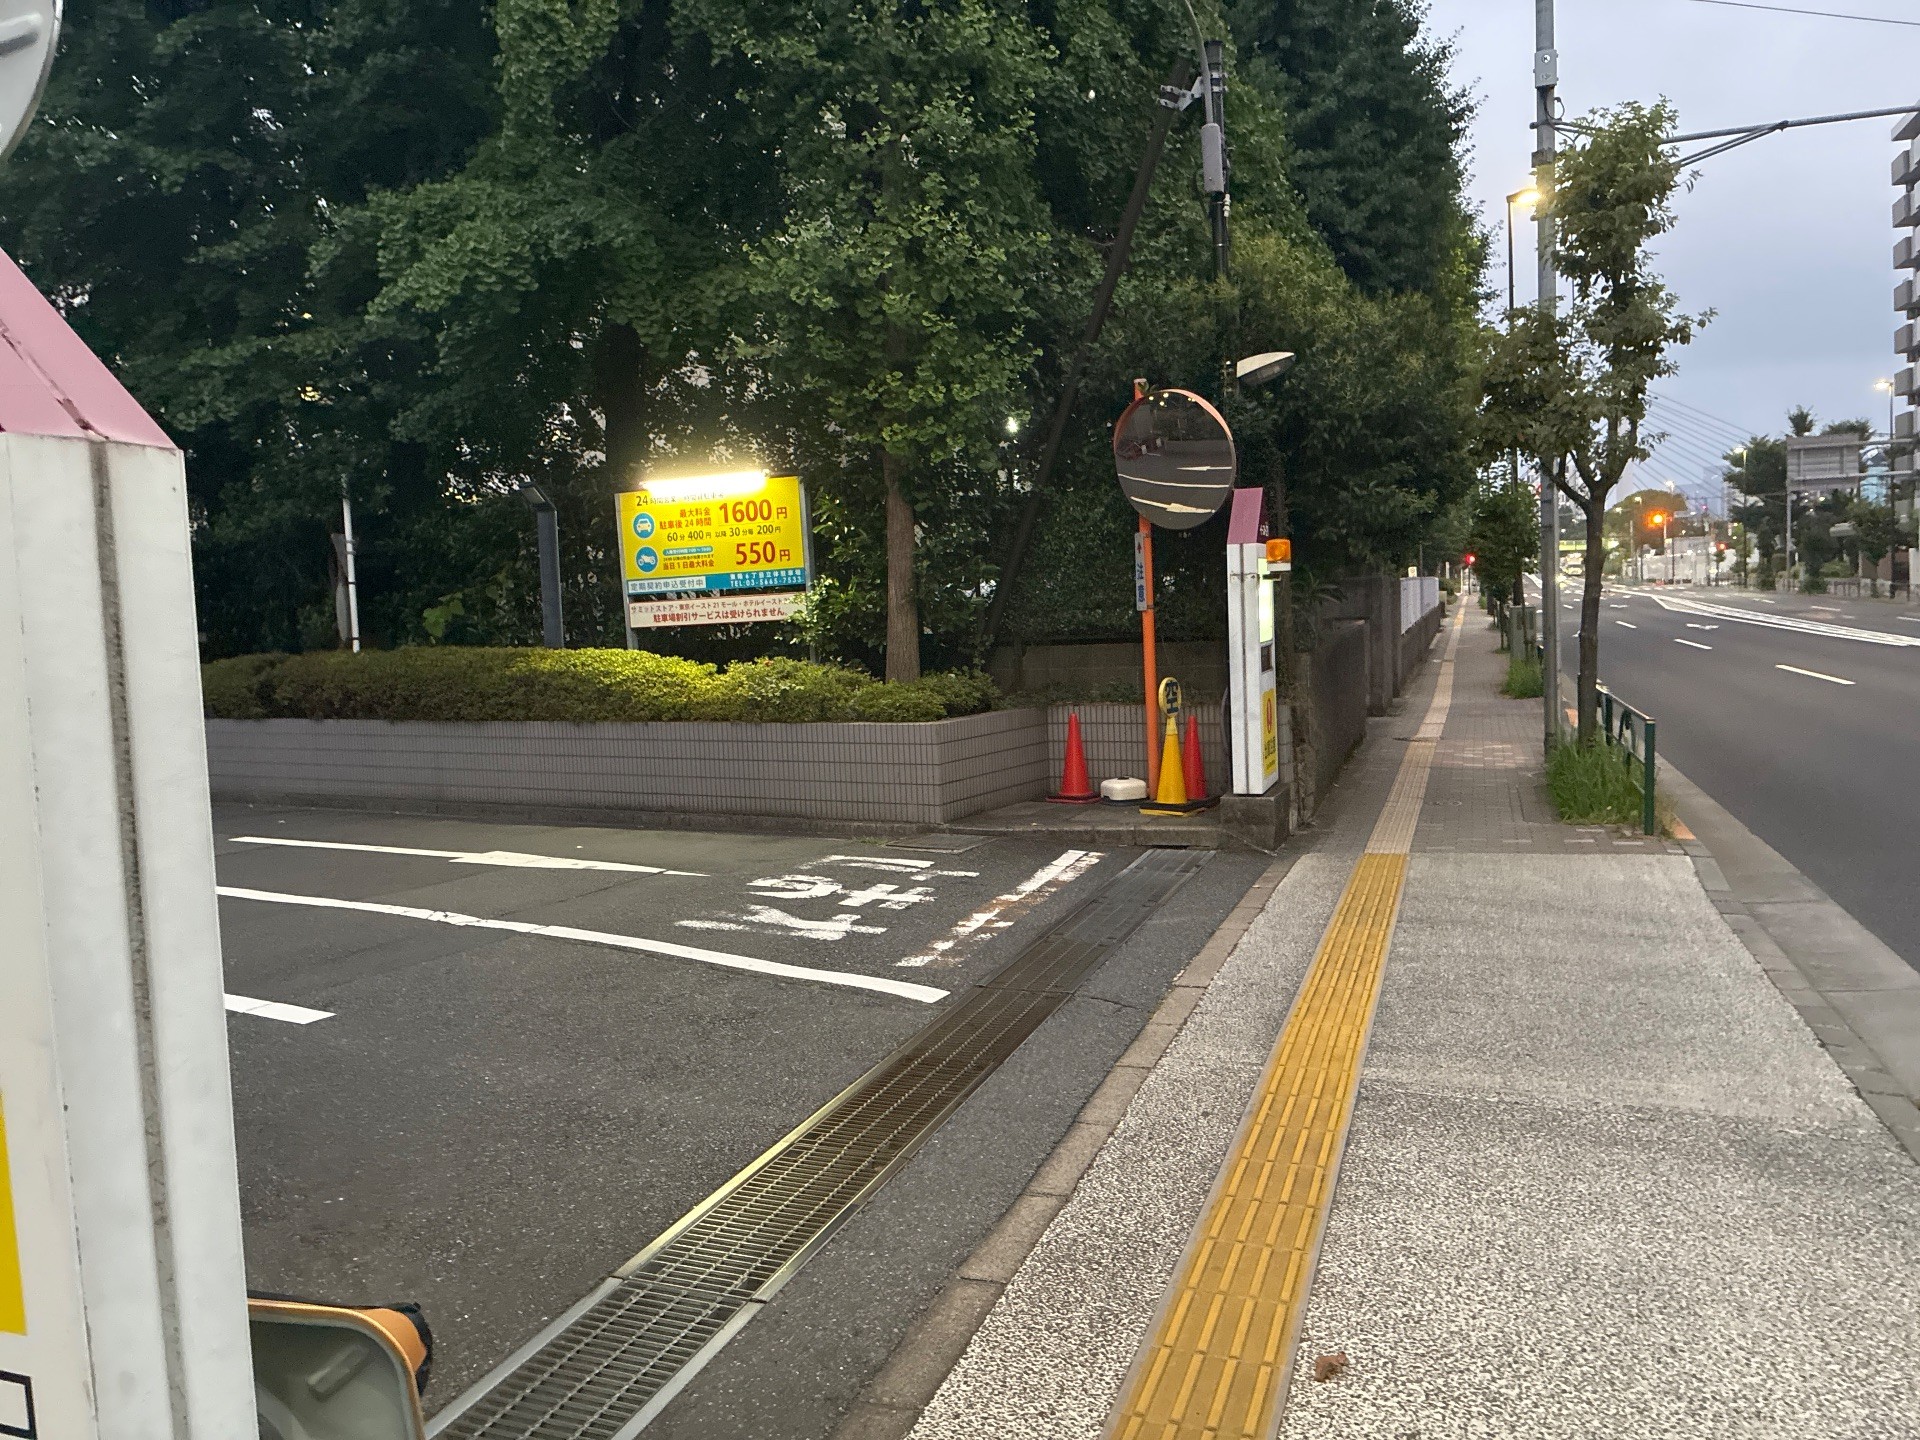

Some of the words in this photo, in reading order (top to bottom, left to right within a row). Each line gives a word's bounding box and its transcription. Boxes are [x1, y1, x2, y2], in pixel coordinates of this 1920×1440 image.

[680, 506, 711, 518] 最大料金
[630, 579, 704, 592] 定期契約申込受付中
[1164, 679, 1179, 715] 空
